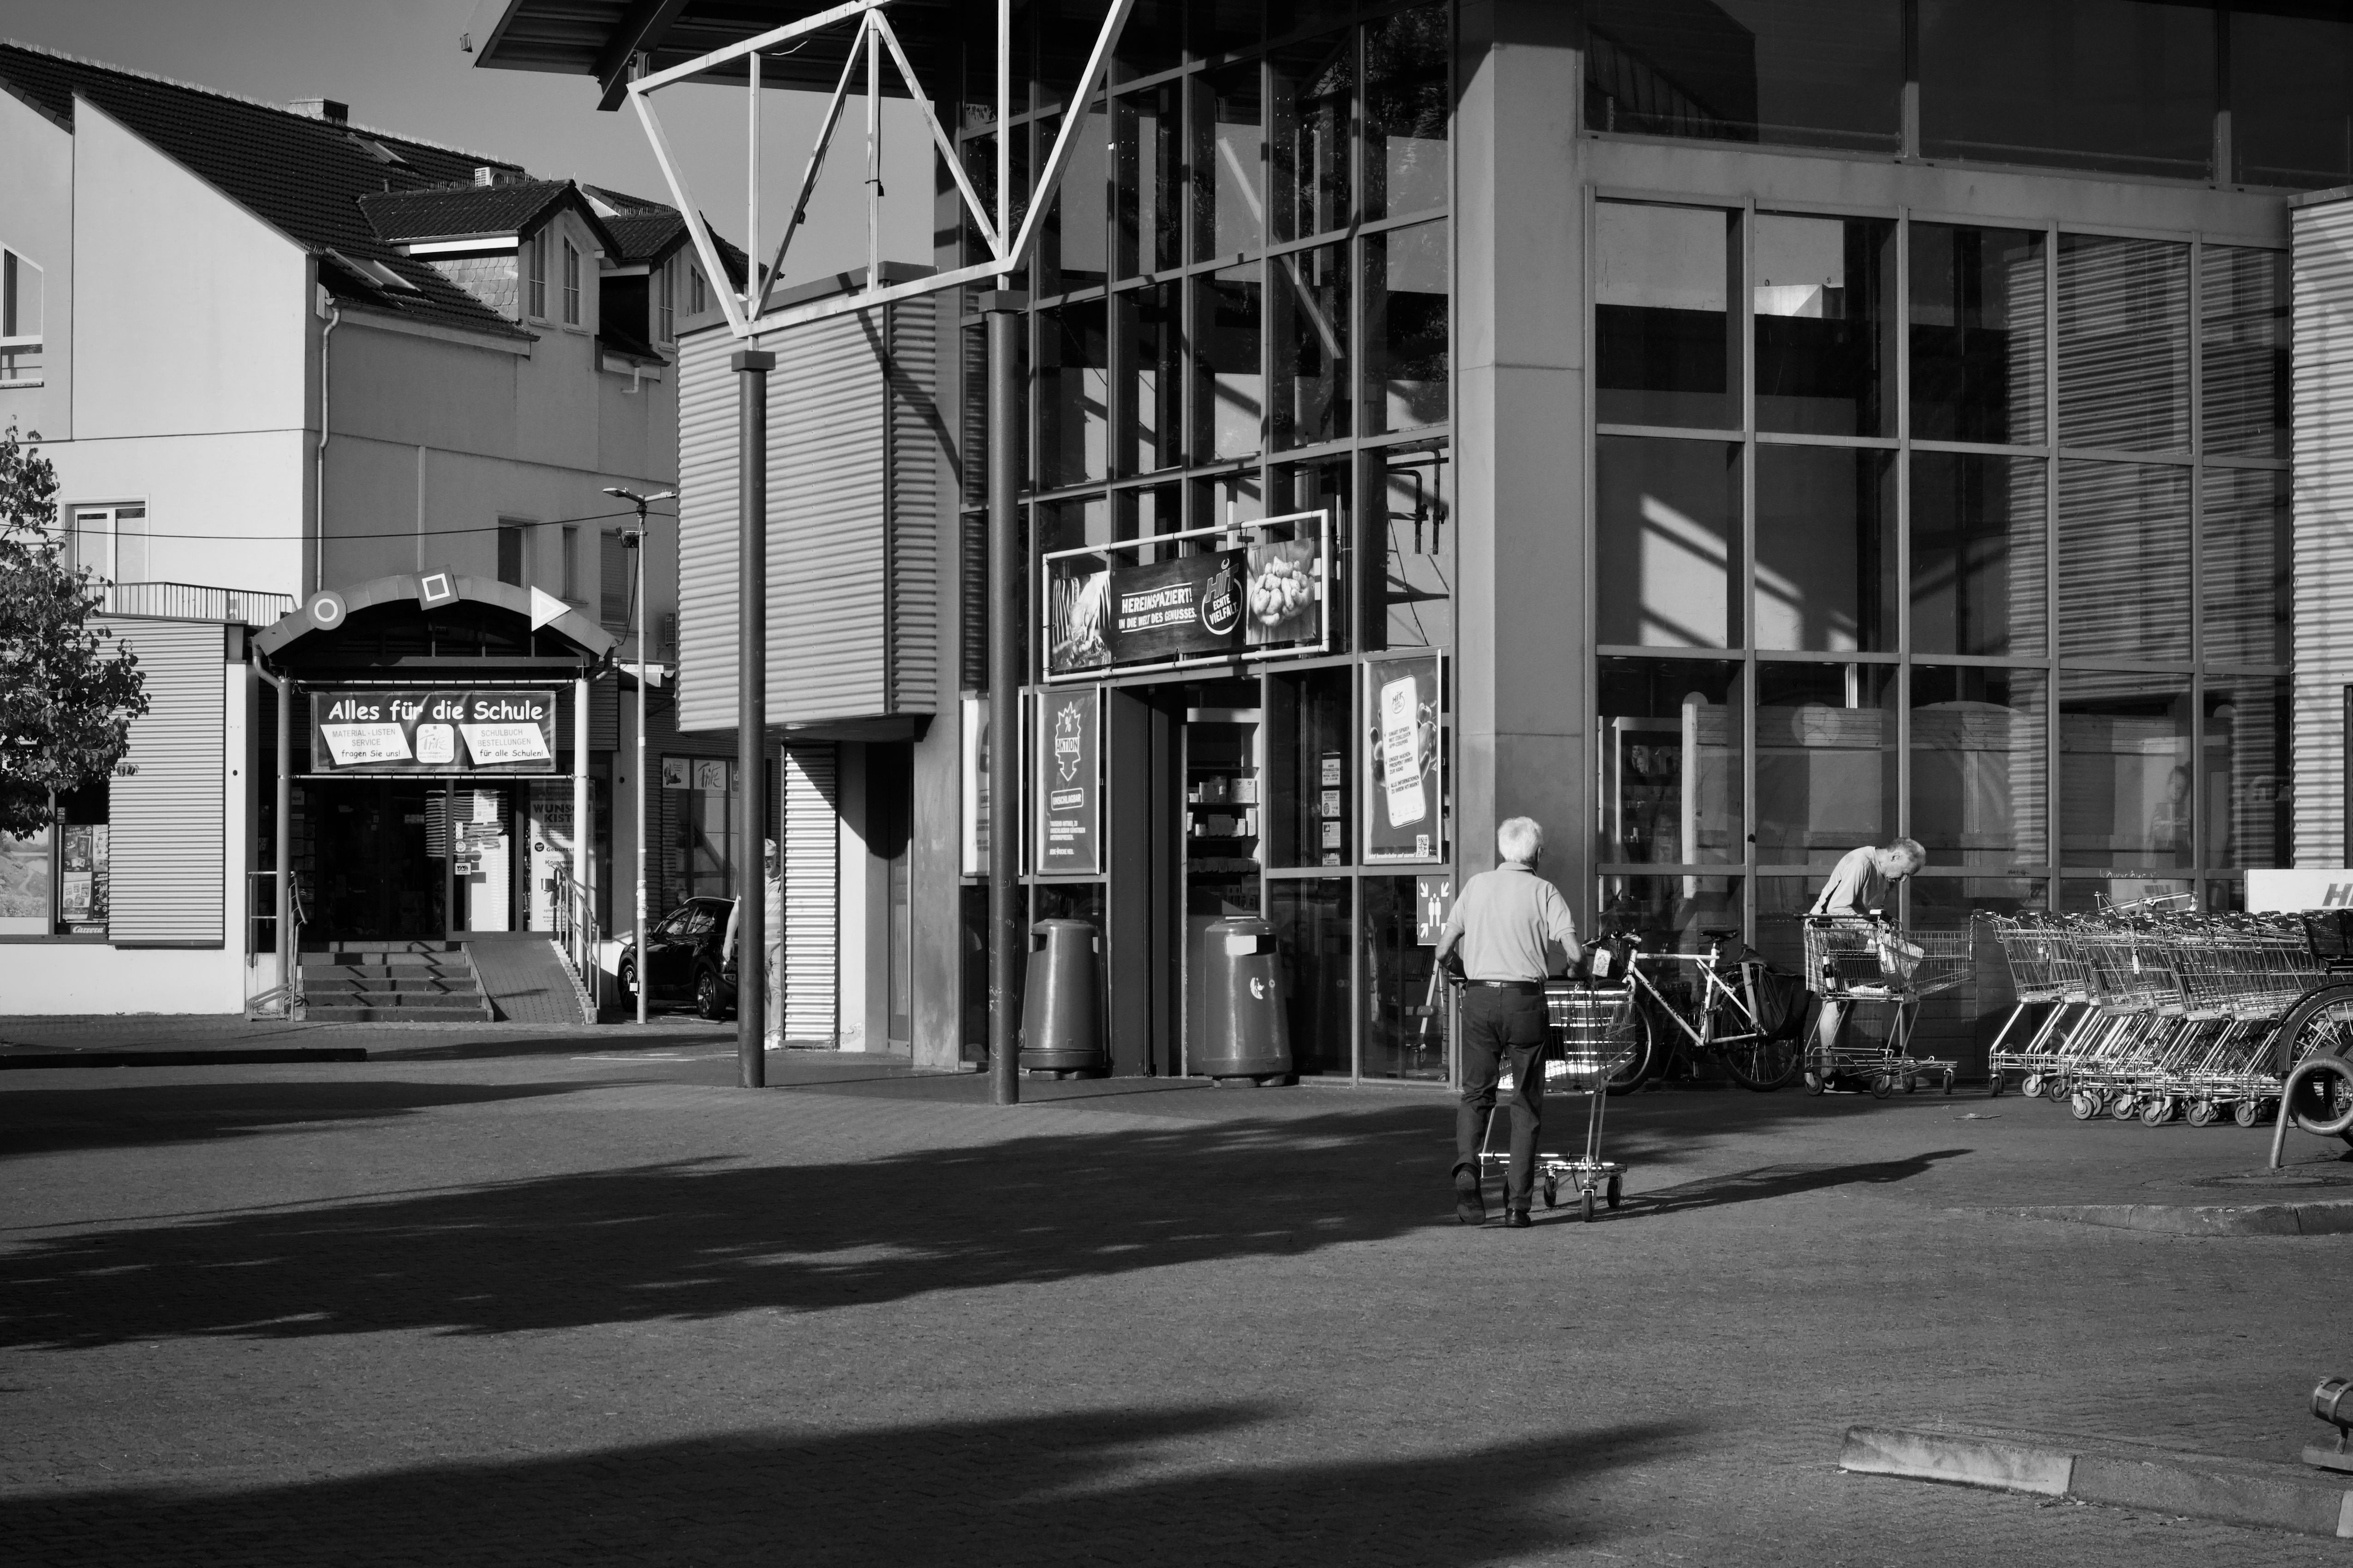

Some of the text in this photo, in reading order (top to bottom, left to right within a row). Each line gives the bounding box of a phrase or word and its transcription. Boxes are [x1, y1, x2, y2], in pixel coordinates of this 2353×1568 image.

[1205, 559, 1239, 603] HIT
[1122, 588, 1192, 613] HEREINSPAZIERT!
[1213, 594, 1231, 611] ECHTE
[1119, 607, 1197, 629] IN DIE WELT DES GENUSSES.
[1209, 602, 1239, 625] VIELFALT.
[1393, 691, 1403, 704] HIT
[328, 700, 542, 721] Alles für die Schule
[477, 738, 531, 747] BESTELLUNGEN
[1057, 739, 1078, 751] AKTION
[342, 750, 366, 759] fragen
[1053, 794, 1081, 805] UNSCHLAGBAR
[533, 804, 590, 813] WUNS
[544, 814, 574, 822] KIST
